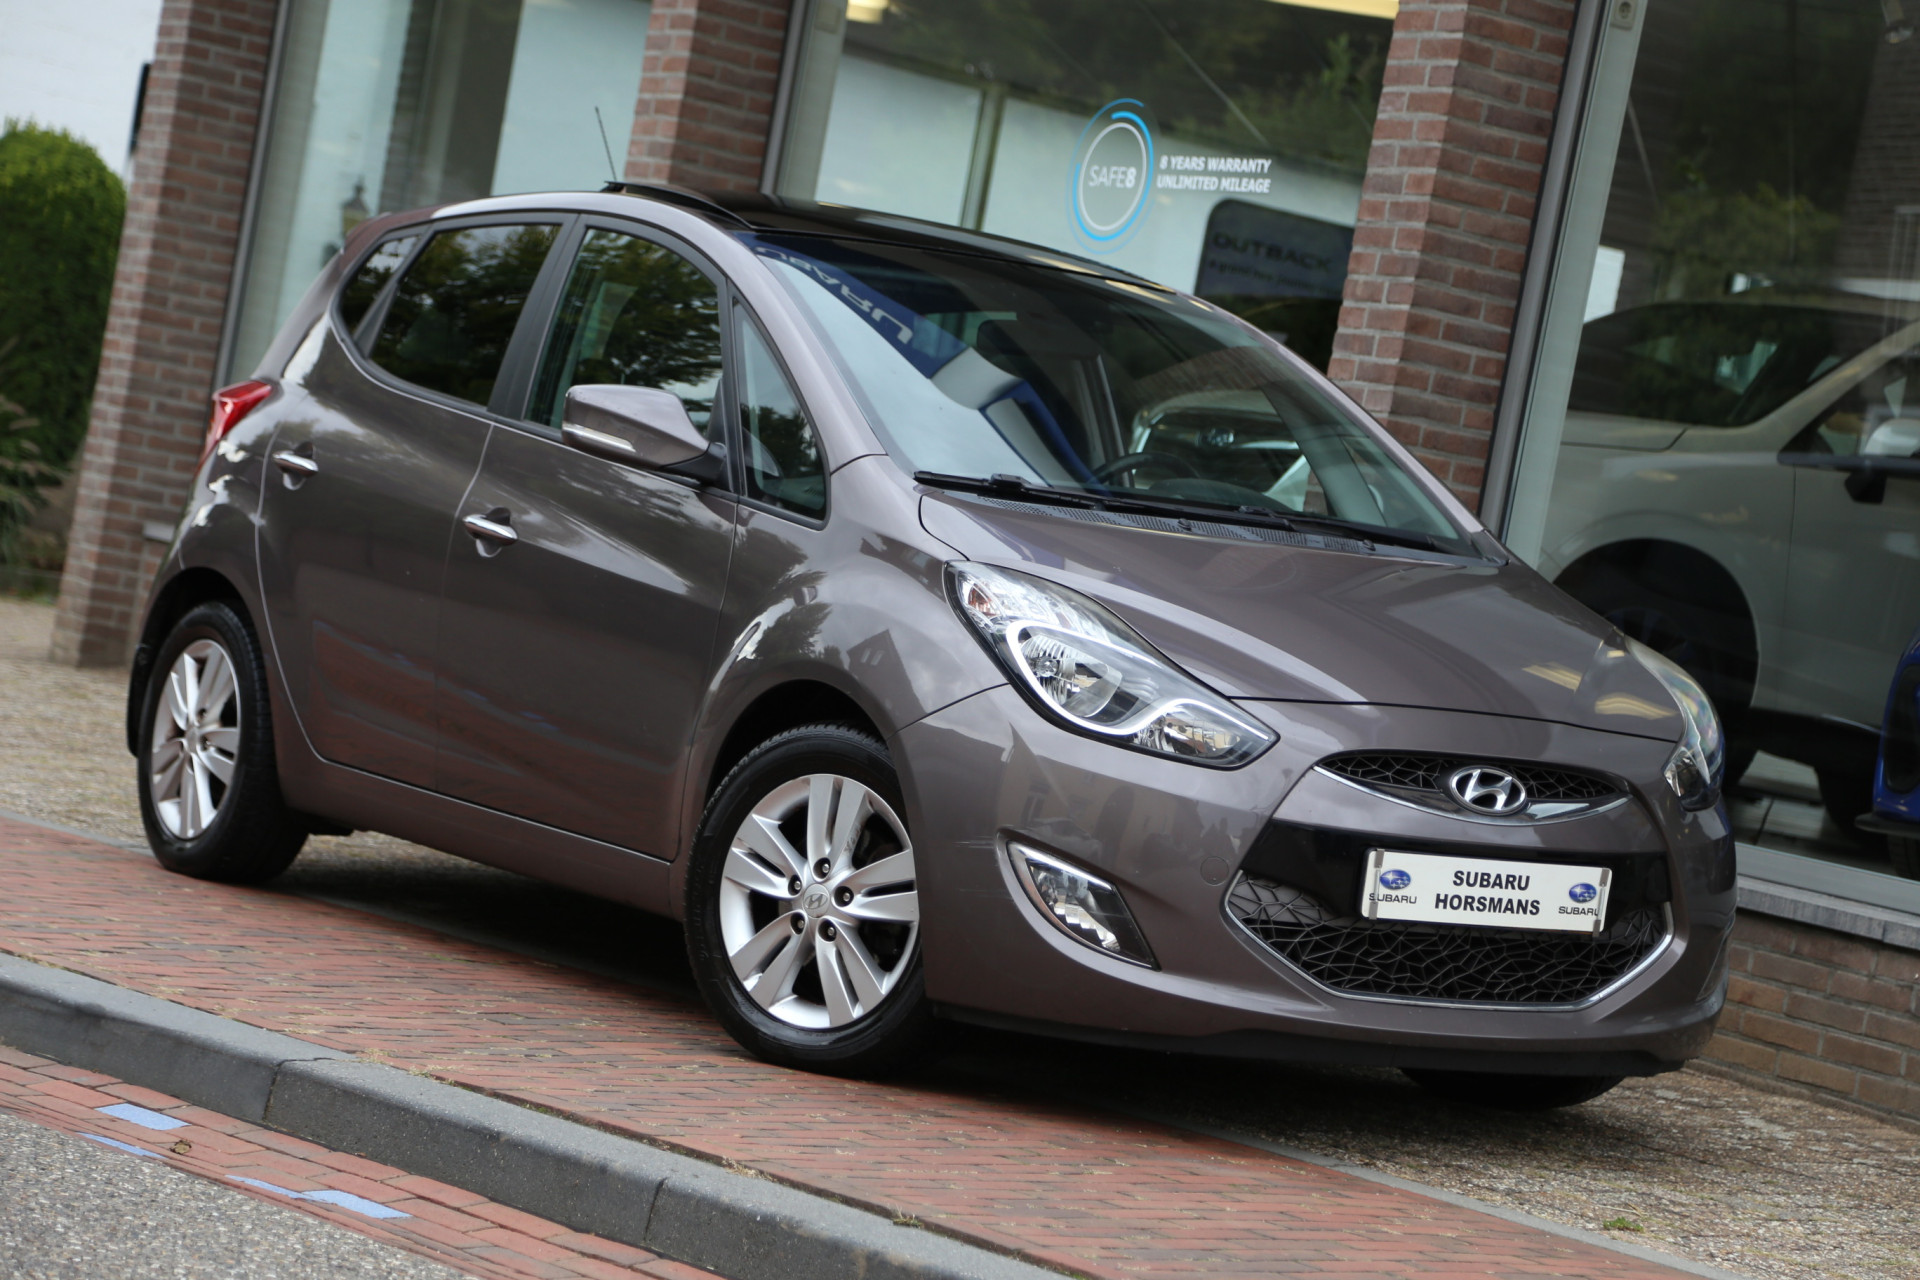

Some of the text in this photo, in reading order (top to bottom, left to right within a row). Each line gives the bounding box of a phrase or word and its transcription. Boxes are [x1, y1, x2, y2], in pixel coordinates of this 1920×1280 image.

[1160, 155, 1272, 174] 8 YEARS WARRANTY
[1089, 165, 1137, 188] SAFE8
[1156, 174, 1271, 193] UNLIMITED MILEAGE
[1212, 231, 1332, 272] OUTBACK
[1452, 870, 1530, 891] SUBARU
[1368, 892, 1417, 904] SUBARU
[1434, 893, 1540, 916] HORSMANS
